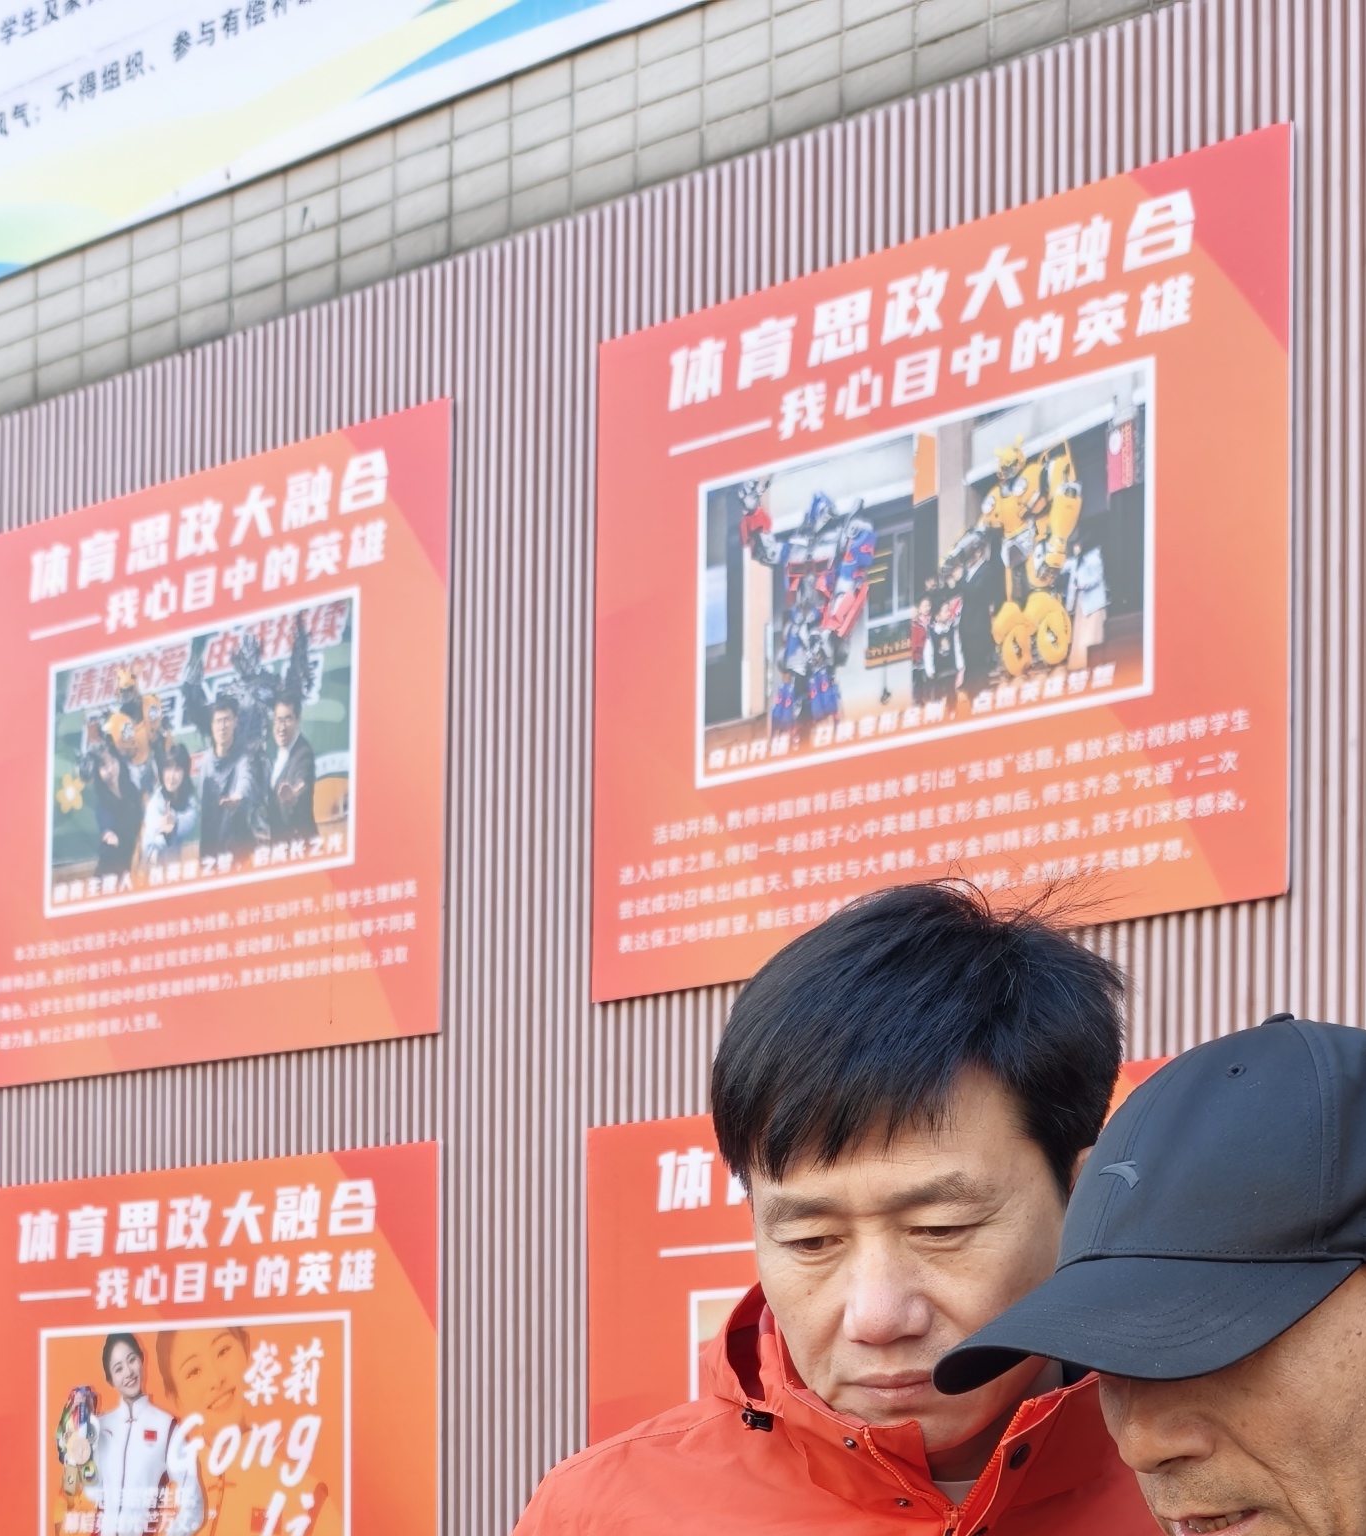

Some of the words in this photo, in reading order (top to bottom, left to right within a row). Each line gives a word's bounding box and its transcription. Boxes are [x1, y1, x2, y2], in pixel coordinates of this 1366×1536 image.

[667, 188, 1196, 411] 体育思政大融合
[29, 449, 390, 603] 体育思政大融合
[657, 1146, 751, 1212] 体
[18, 1178, 377, 1264] 体育思政大融合
[243, 1336, 325, 1407] 龚莉
[165, 1412, 321, 1488] Gong
